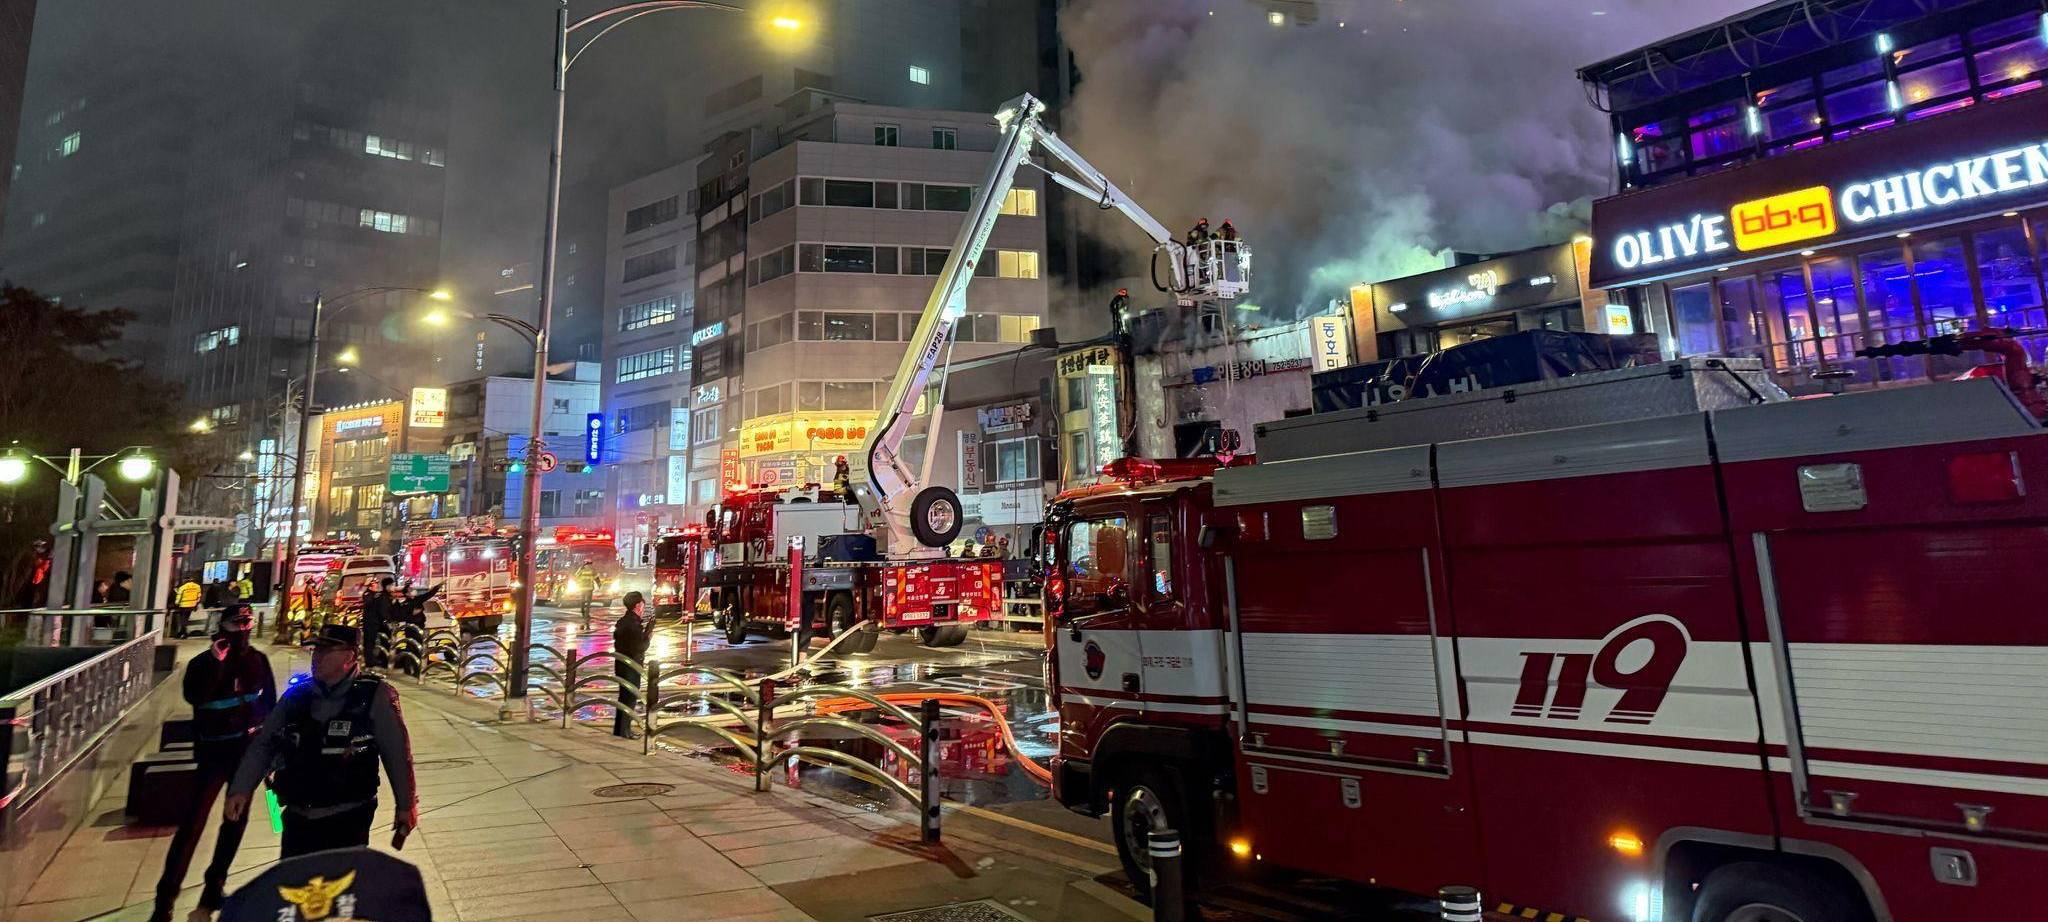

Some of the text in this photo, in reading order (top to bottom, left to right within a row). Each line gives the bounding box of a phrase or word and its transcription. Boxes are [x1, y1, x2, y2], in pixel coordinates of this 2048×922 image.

[1615, 214, 1729, 268] OLIVE
[927, 332, 943, 361] EAP28
[1510, 620, 1687, 725] 119
